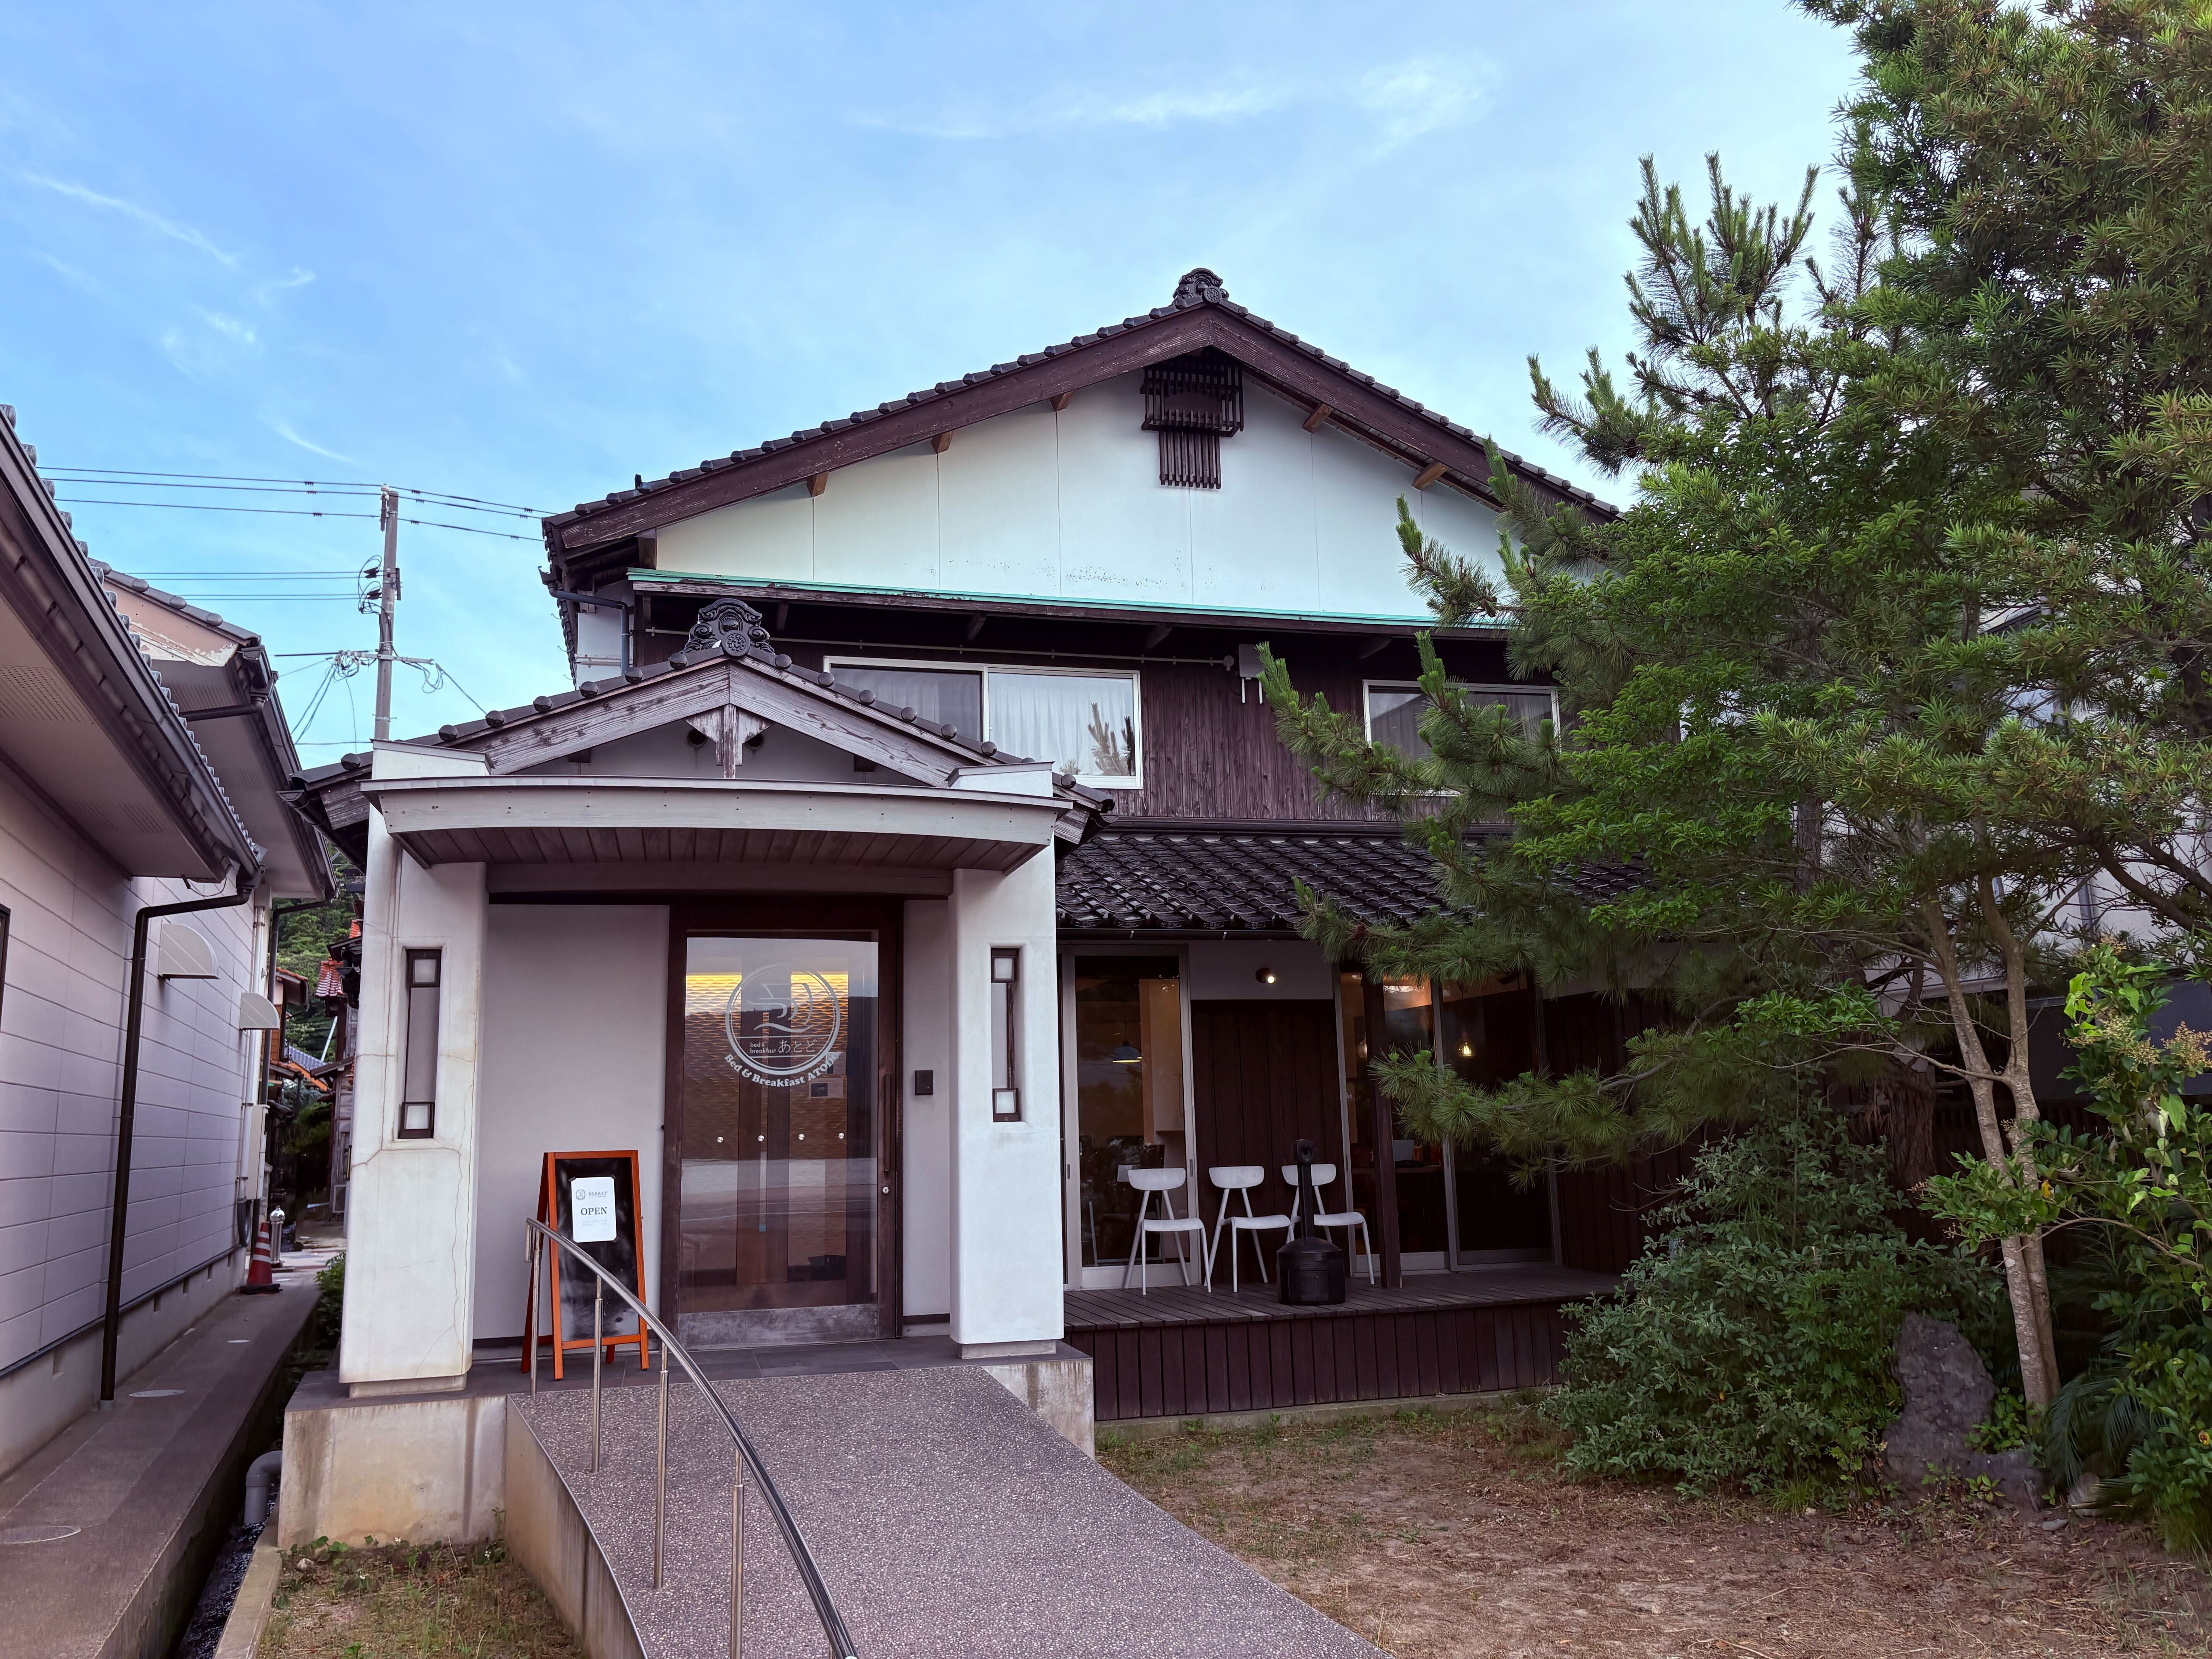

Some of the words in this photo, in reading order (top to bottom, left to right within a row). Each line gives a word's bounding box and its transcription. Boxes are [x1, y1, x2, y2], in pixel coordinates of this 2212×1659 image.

[778, 1039, 817, 1053] あとど
[724, 1053, 743, 1072] Bed
[742, 1069, 752, 1078] &
[751, 1073, 805, 1087] Breakfast
[580, 1207, 607, 1215] OPEN
